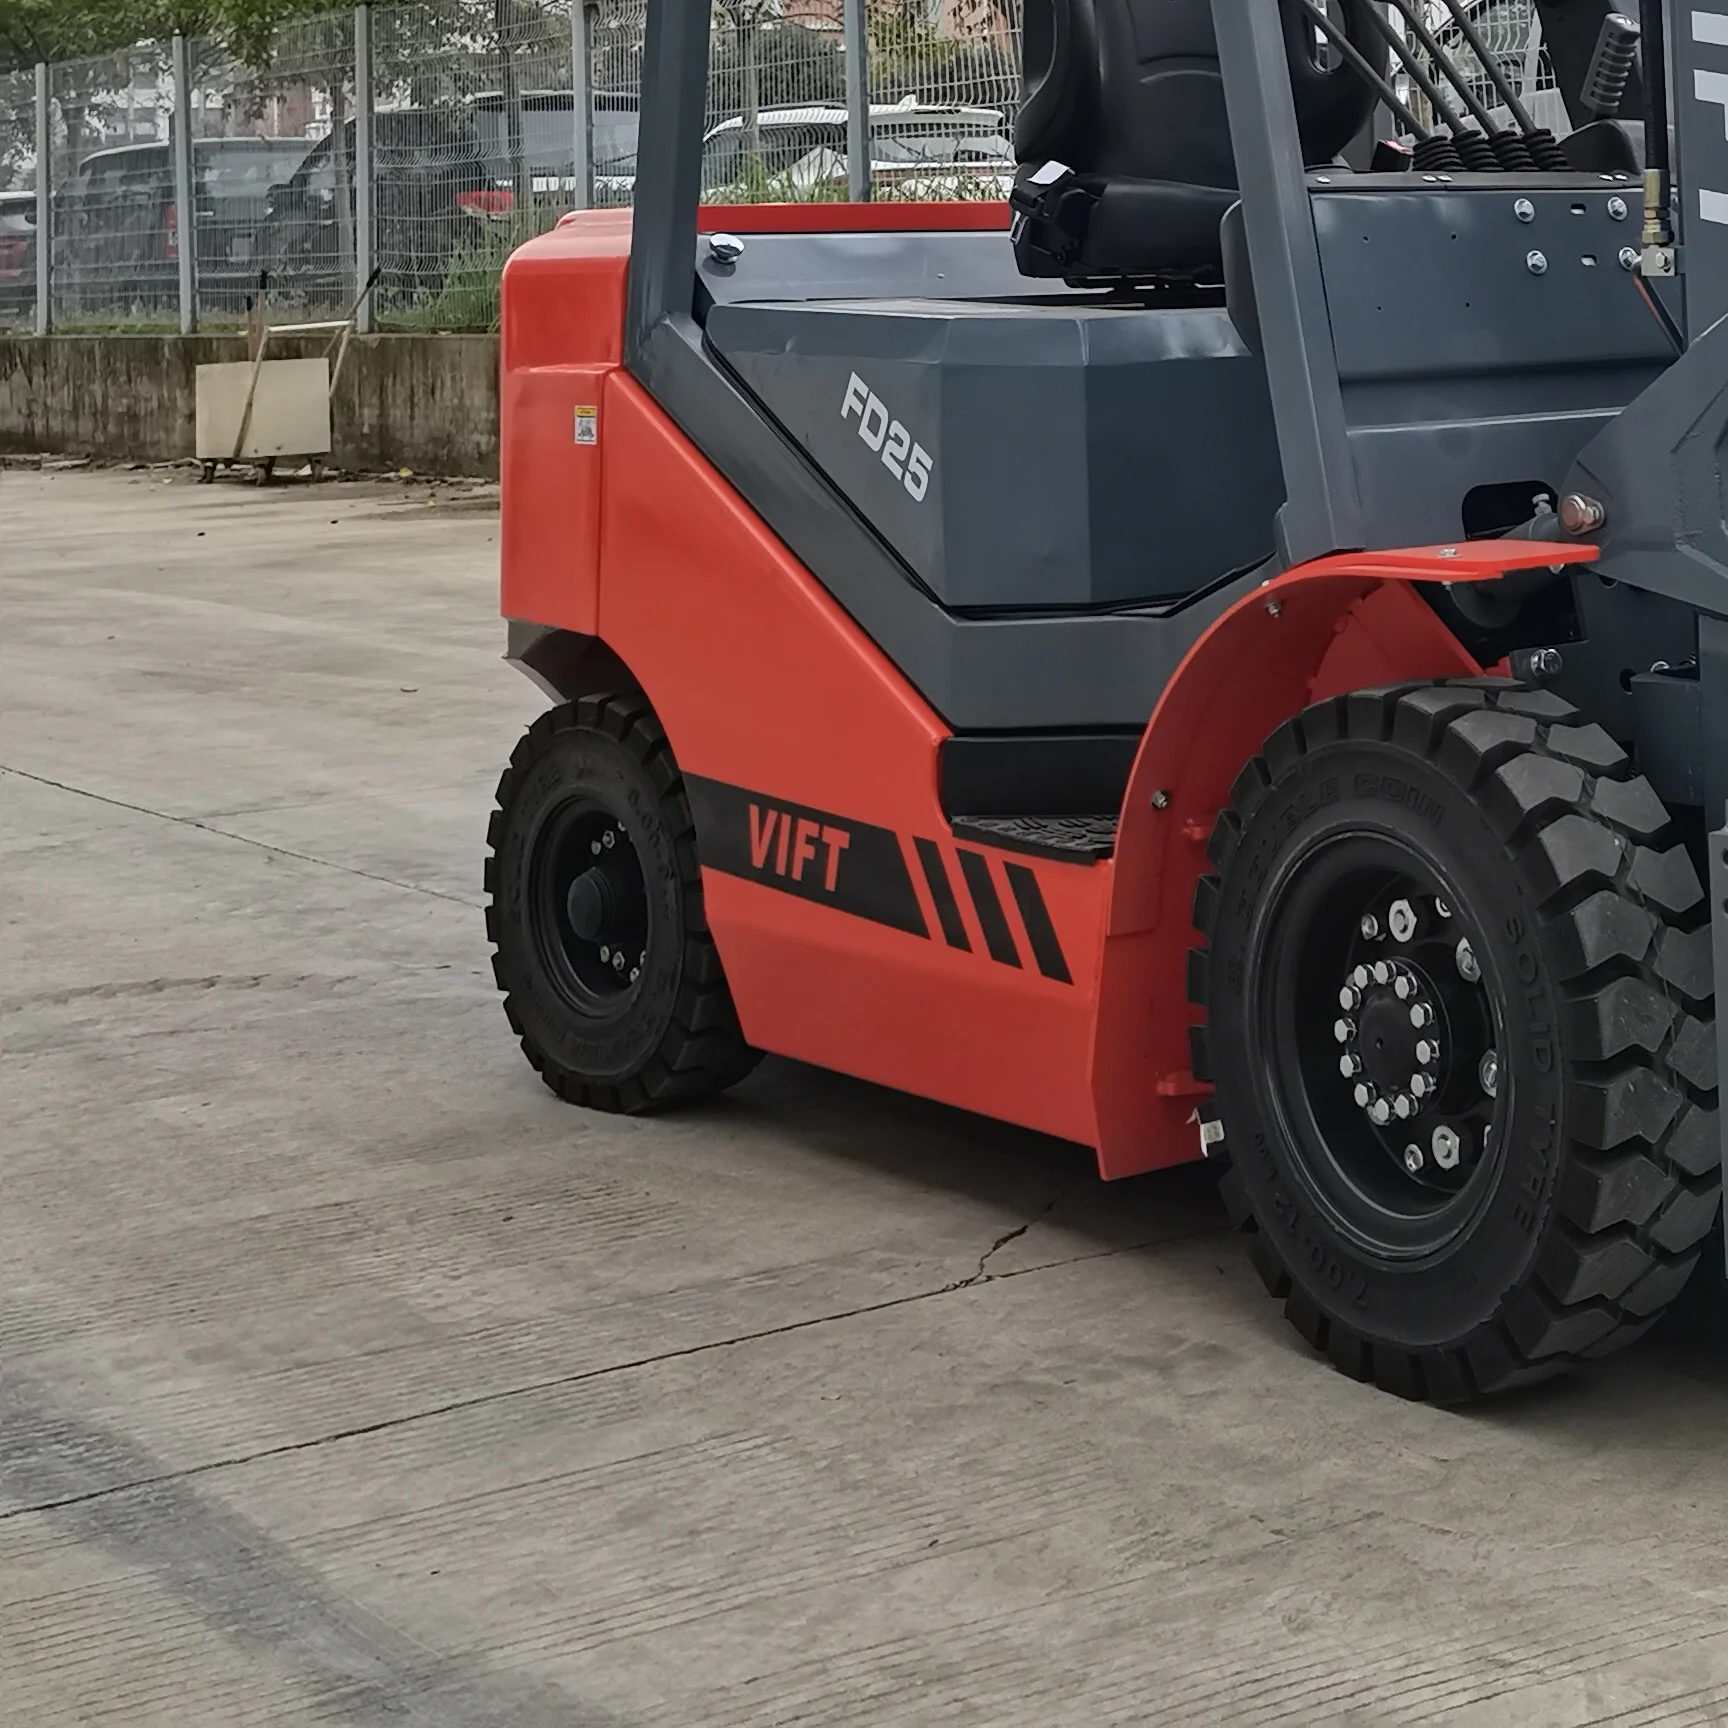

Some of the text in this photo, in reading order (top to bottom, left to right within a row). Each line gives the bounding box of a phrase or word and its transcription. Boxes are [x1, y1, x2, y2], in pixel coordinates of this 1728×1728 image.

[840, 372, 933, 502] FD25
[748, 803, 850, 891] VIFT
[1354, 772, 1445, 826] COIN
[1505, 908, 1558, 1237] SOLID TYRE
